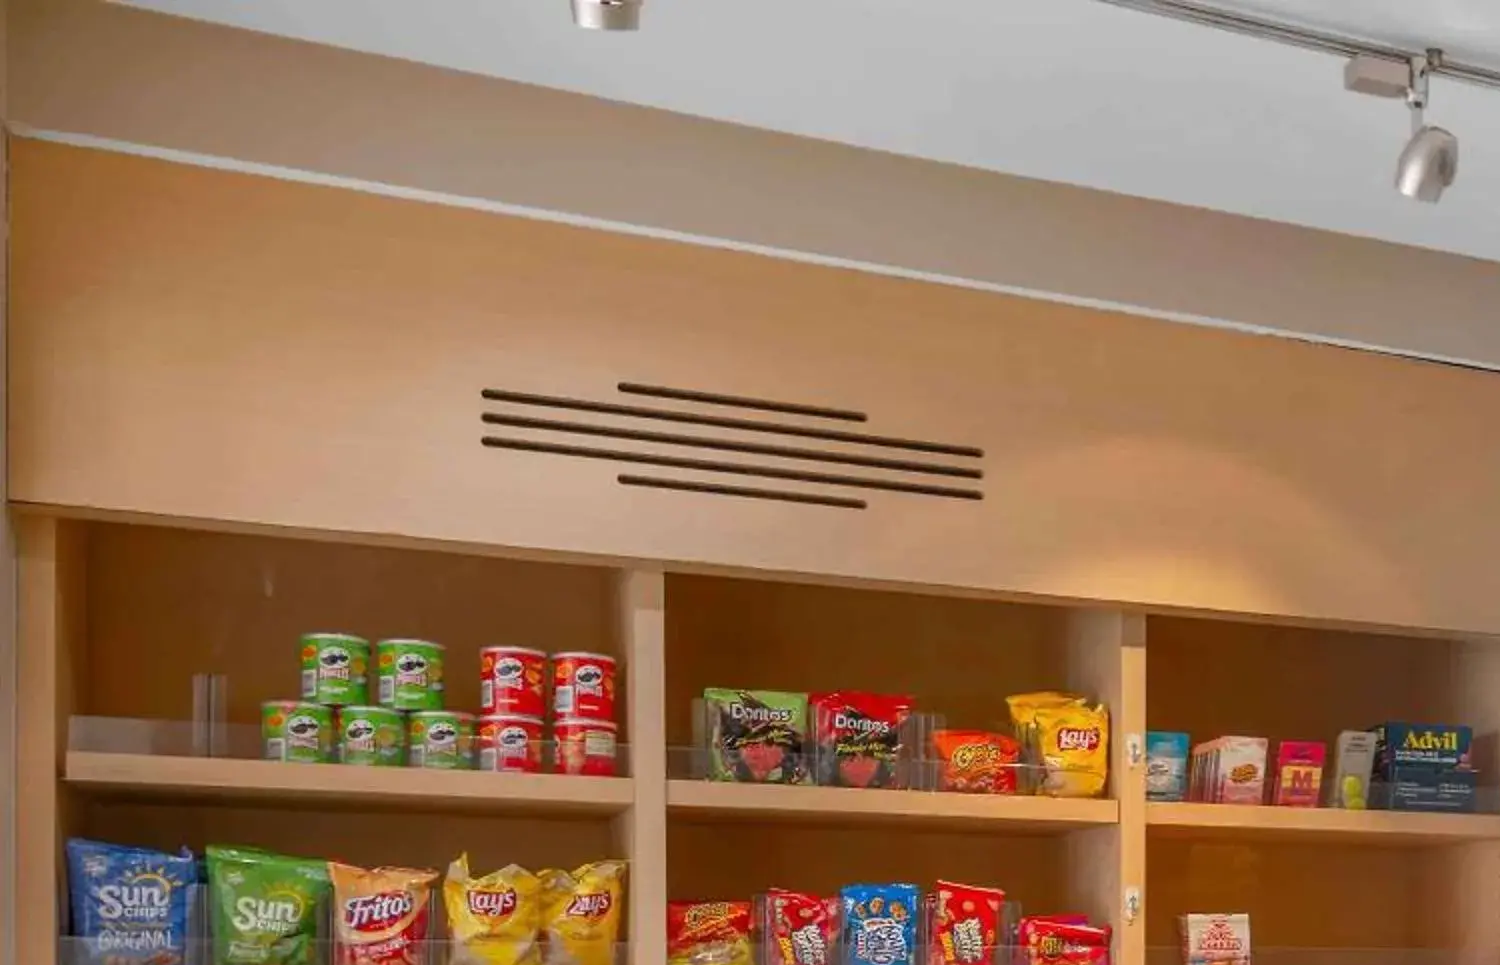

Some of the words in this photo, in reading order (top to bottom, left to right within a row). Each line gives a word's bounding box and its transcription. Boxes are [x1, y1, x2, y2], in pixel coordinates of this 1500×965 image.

[731, 703, 791, 720] Doritos
[835, 714, 889, 733] Doritos
[1059, 728, 1098, 750] Lay's
[1403, 730, 1457, 750] Advil
[99, 885, 170, 919] Sun
[347, 892, 411, 928] Fritos
[465, 889, 515, 916] Lay's
[236, 897, 301, 931] Sun
[97, 929, 174, 952] ORIGINAL
